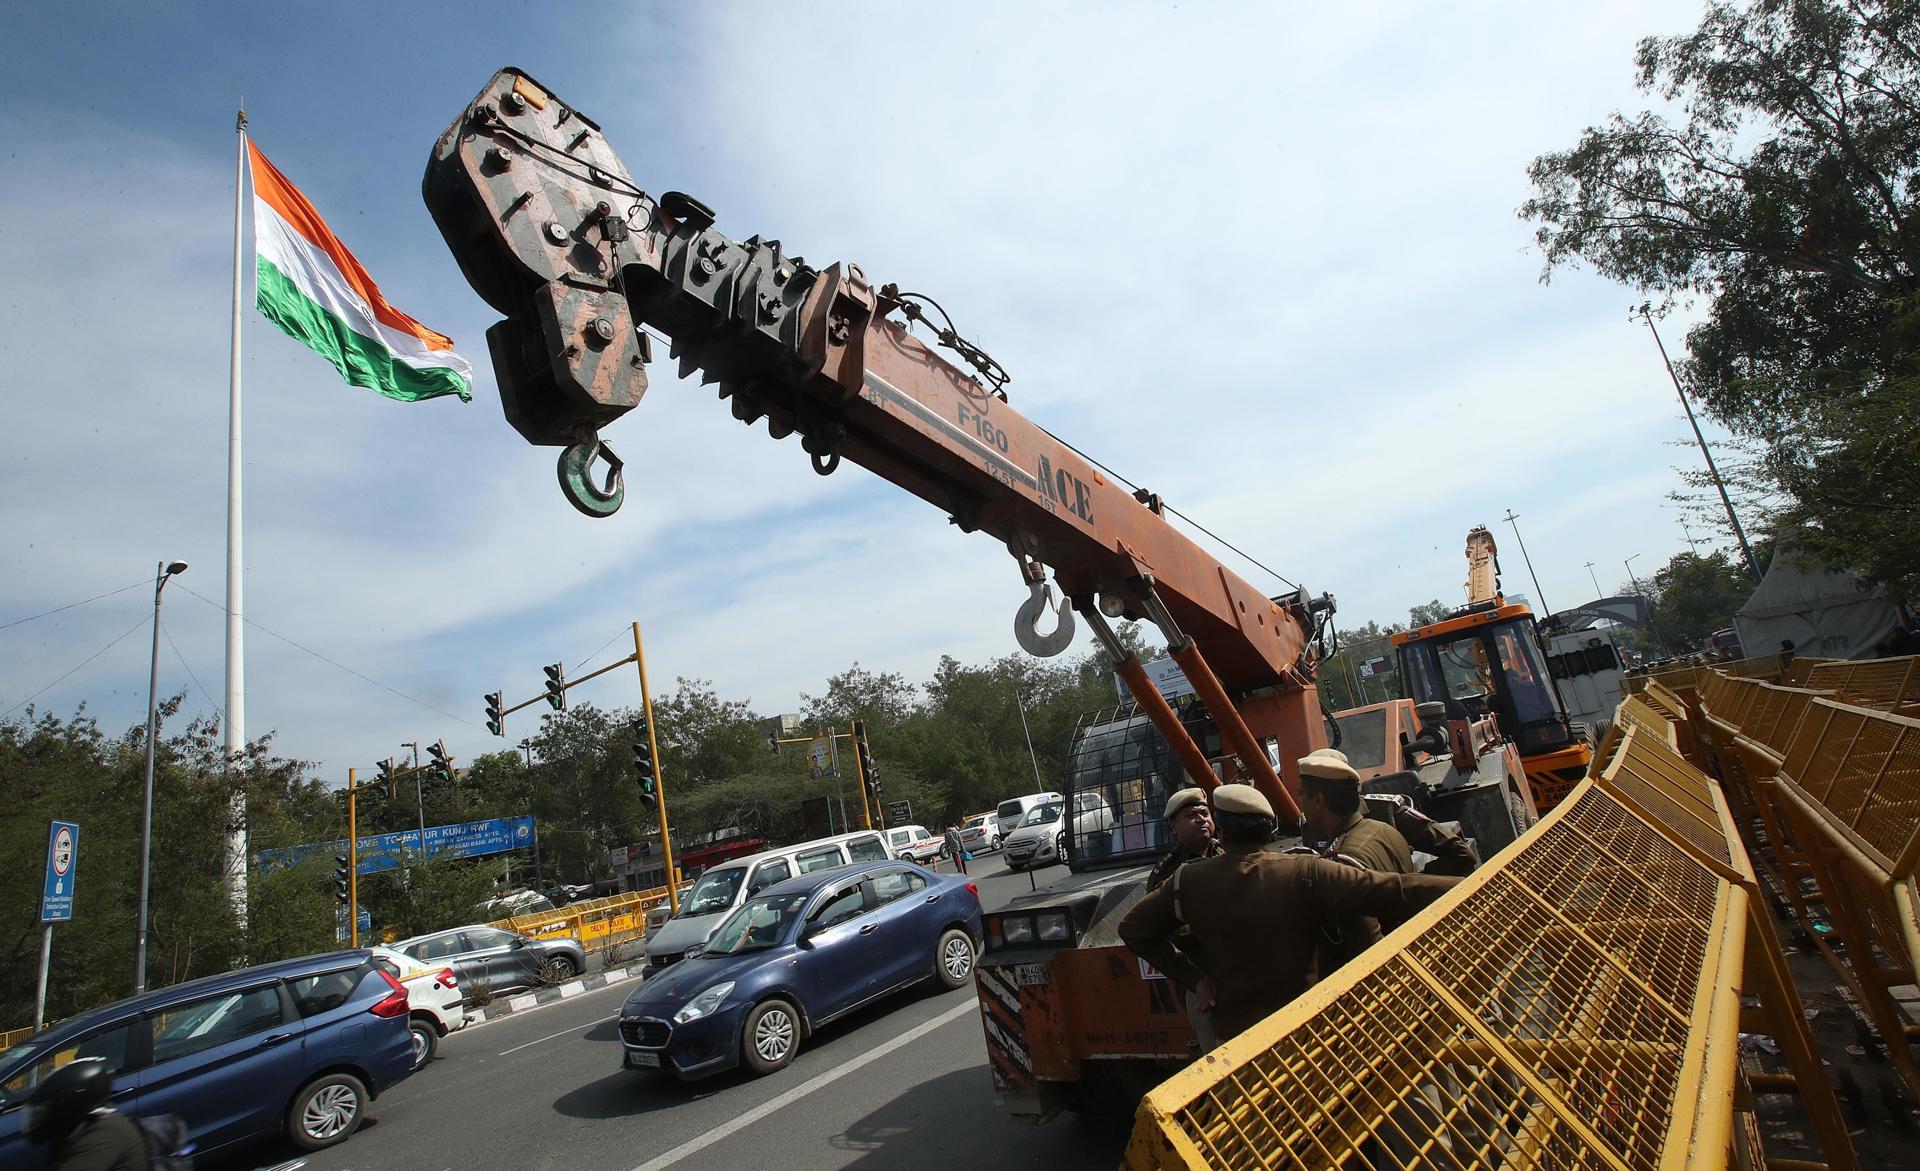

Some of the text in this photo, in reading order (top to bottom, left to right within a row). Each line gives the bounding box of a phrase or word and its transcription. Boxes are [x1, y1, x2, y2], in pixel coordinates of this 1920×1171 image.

[957, 401, 1009, 453] F160
[1036, 453, 1095, 526] ACE
[442, 826, 467, 838] KUNJ
[590, 924, 605, 933] DELHI
